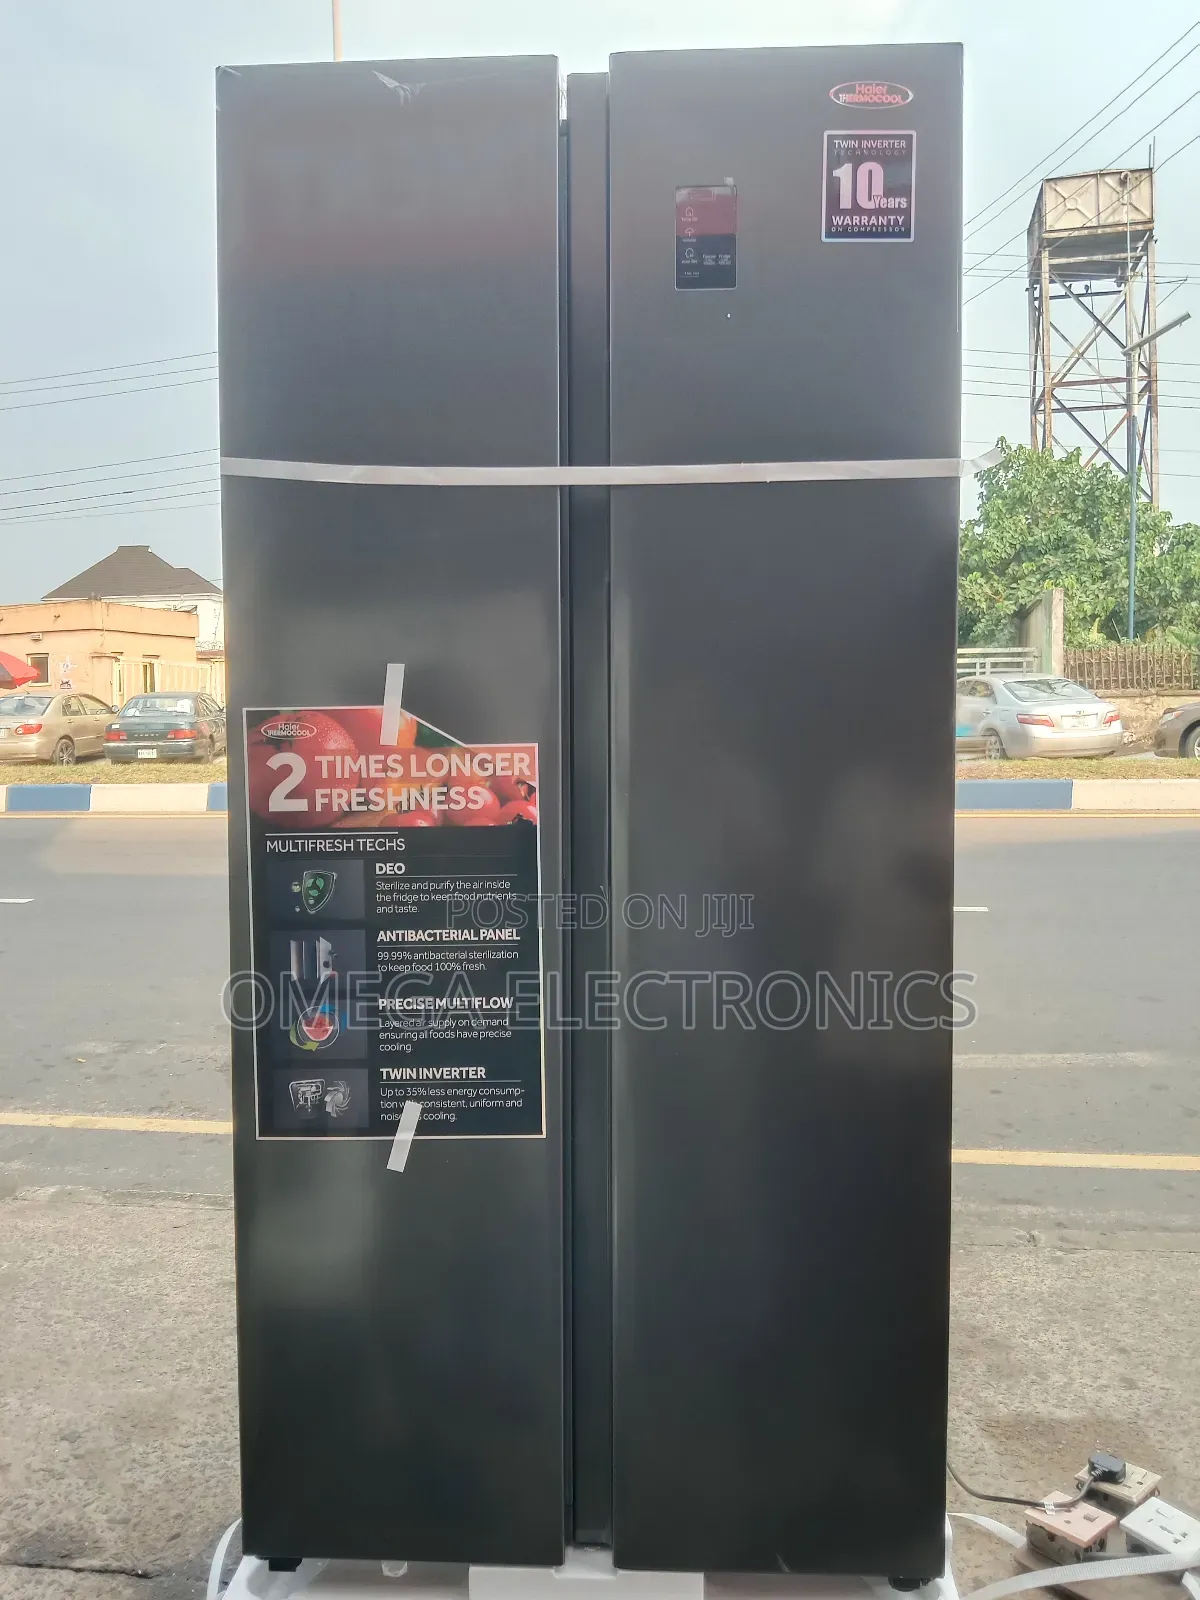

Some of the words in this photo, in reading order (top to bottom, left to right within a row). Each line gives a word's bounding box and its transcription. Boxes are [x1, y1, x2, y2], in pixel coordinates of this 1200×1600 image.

[855, 83, 888, 94] Haier
[839, 93, 904, 104] THERMOCOOL
[833, 139, 859, 149] TWIN
[861, 139, 906, 149] INVERTER
[832, 161, 884, 210] 10
[873, 194, 908, 209] Years
[832, 215, 905, 226] WARRANTY
[267, 729, 311, 737] THERMOCOOL
[278, 723, 300, 731] Haier
[314, 753, 404, 780] TIMES
[409, 751, 532, 779] LONGER
[265, 751, 309, 813] 2
[314, 785, 486, 813] FRESHNESS
[265, 838, 355, 853] MULTIFRESH
[356, 837, 406, 852] TECHS
[375, 862, 406, 875] DEO
[375, 880, 411, 890] Sterilize
[411, 880, 429, 890] and
[429, 880, 455, 892] purify
[455, 879, 472, 889] the
[472, 880, 484, 889] air
[484, 879, 511, 889] inside
[375, 892, 392, 902] the
[392, 892, 419, 903] fridge
[420, 893, 430, 902] to
[431, 892, 454, 903] keep
[454, 891, 476, 901] food
[476, 891, 517, 901] nutrients
[376, 904, 394, 913] and
[394, 904, 420, 913] taste.
[376, 929, 479, 942] ANTIBACTERIAL
[479, 928, 521, 941] PANEL
[377, 951, 412, 961] 99.99%
[413, 950, 468, 960] antibacterial
[468, 949, 519, 959] sterilization
[377, 963, 388, 972] to
[388, 963, 411, 973] keep
[411, 962, 433, 972] food
[435, 962, 461, 971] 100%
[462, 961, 488, 971] fresh.
[378, 998, 434, 1010] PRECISE
[435, 996, 514, 1010] MULTIFLOW
[379, 1018, 415, 1030] Layered
[428, 1018, 457, 1028] supply
[470, 1017, 509, 1027] demand
[379, 1031, 418, 1041] ensuring
[429, 1029, 456, 1039] foods
[456, 1029, 478, 1038] have
[479, 1029, 512, 1040] precise
[379, 1043, 413, 1053] cooling.
[380, 1067, 417, 1081] TWIN
[418, 1066, 486, 1080] INVERTER
[380, 1087, 394, 1098] Up
[395, 1088, 405, 1097] to
[405, 1087, 426, 1097] 35%
[427, 1087, 446, 1096] less
[446, 1088, 478, 1098] energy
[478, 1087, 525, 1097] consump-
[380, 1099, 398, 1108] tion
[420, 1099, 468, 1109] consistent,
[469, 1098, 505, 1108] uniform
[505, 1098, 523, 1107] and
[423, 1111, 457, 1122] cooling.
